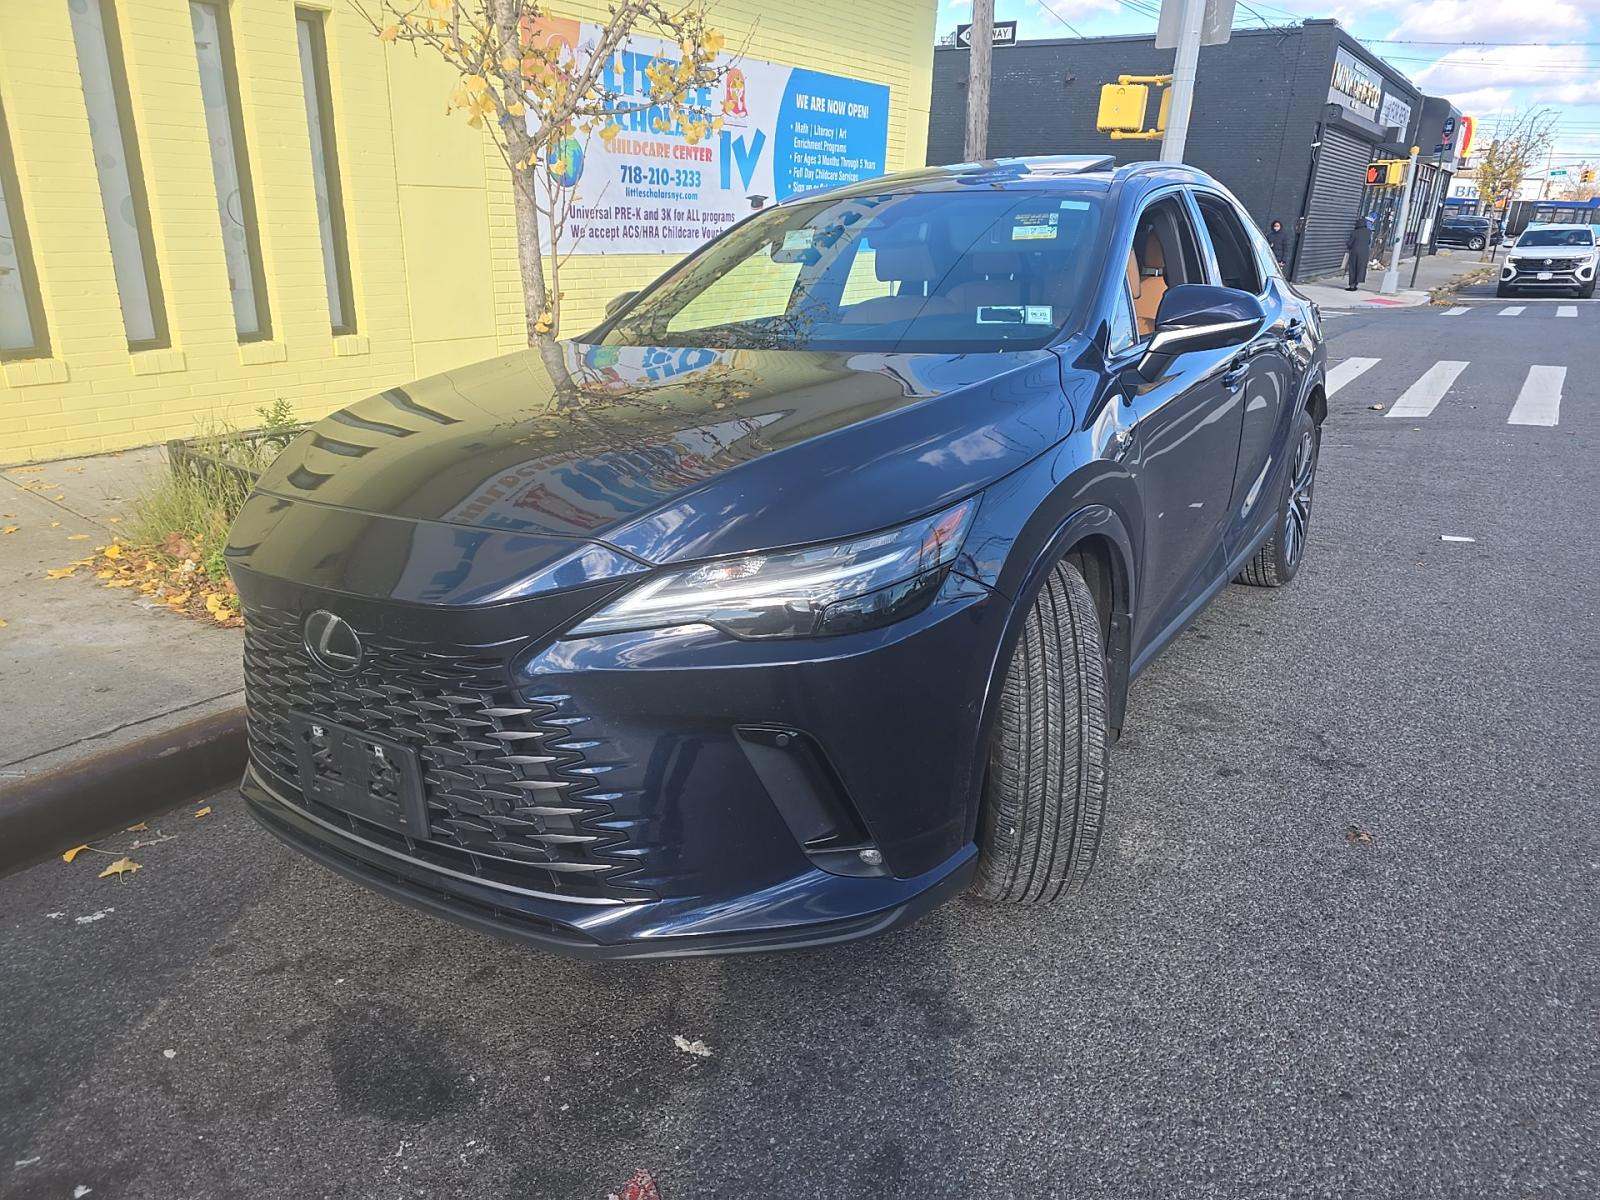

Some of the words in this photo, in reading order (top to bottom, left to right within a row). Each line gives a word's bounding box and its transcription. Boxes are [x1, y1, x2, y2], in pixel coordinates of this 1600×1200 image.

[796, 93, 809, 110] WE
[810, 96, 826, 112] ARE
[827, 98, 846, 115] NOW
[847, 103, 869, 119] OPEN!
[795, 122, 809, 134] Math
[814, 125, 834, 139] Literacy
[839, 128, 847, 139] Art
[604, 139, 671, 159] CHILDCARE
[672, 145, 713, 162] CENTER
[794, 137, 823, 150] Enrichment
[824, 141, 847, 154] Programs
[720, 128, 766, 192] IV
[794, 153, 803, 164] For
[803, 154, 816, 166] Ages
[822, 155, 840, 167] Months
[840, 156, 859, 170] Through
[859, 159, 864, 168] 5
[864, 159, 876, 170] Years
[620, 165, 702, 188] 718-210-3233
[793, 167, 803, 178] Full
[804, 168, 814, 180] Day
[815, 168, 838, 181] Childcare
[839, 171, 859, 182] Services
[625, 187, 698, 202] littlescholarsnyc.com
[569, 205, 612, 220] Universal
[614, 206, 642, 220] PRE-K
[643, 208, 659, 221] and
[661, 208, 672, 221] 3K
[674, 209, 685, 221] for
[687, 209, 700, 221] ALL
[702, 211, 735, 224] programs
[571, 225, 586, 238] We
[588, 226, 620, 241] accept
[622, 225, 660, 239] ACS/HRA
[662, 226, 700, 239] Childcare
